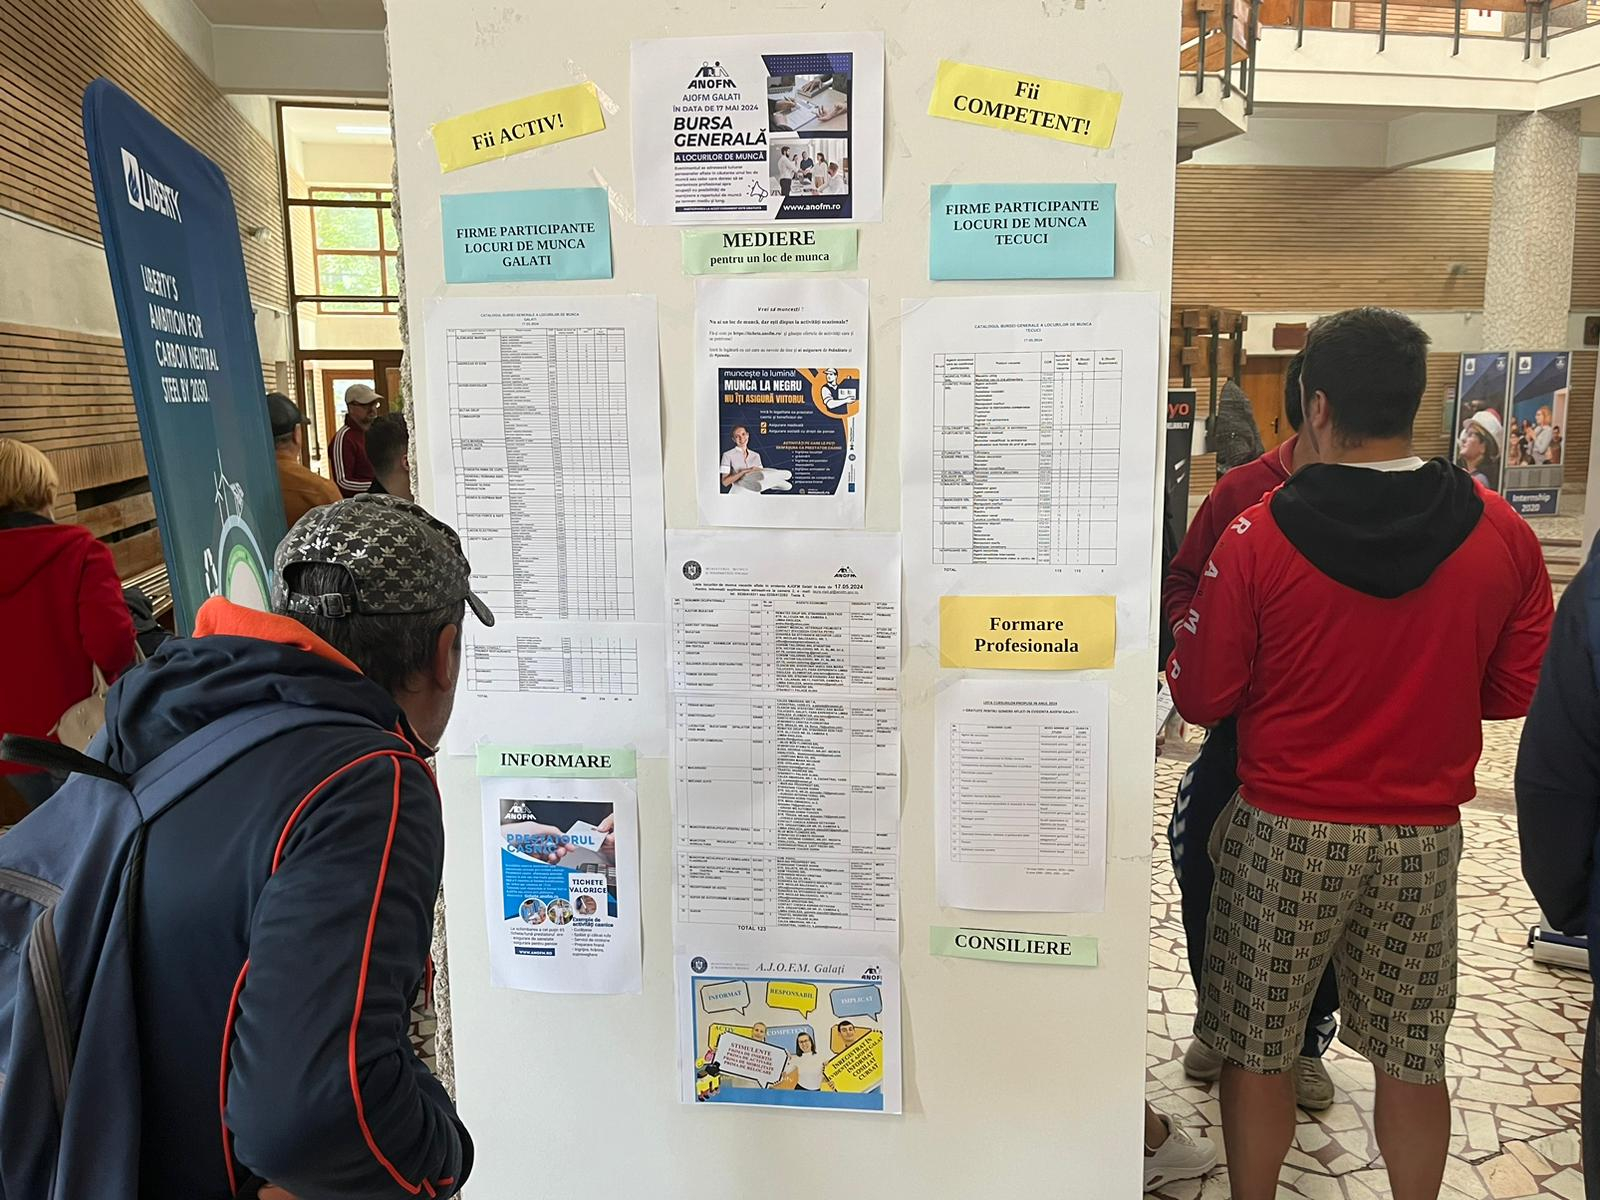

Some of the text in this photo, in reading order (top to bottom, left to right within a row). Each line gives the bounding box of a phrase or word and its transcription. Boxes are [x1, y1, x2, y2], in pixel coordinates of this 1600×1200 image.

[687, 79, 737, 89] ANOFM
[1015, 81, 1040, 100] Fii
[712, 93, 741, 101] GALATI
[741, 104, 759, 112] 2024
[953, 95, 1091, 136] COMPETENT!
[674, 116, 733, 130] BURSA
[472, 113, 564, 150] Fii ACTIV!
[674, 129, 767, 147] GENERALĂ
[682, 153, 723, 161] LOCURILOR
[735, 151, 764, 160] MUNCĂ
[141, 168, 183, 223] LIBERTY
[783, 203, 841, 212] www.anofm.ro
[946, 200, 1099, 215] FIRME PARTICIPANTE
[456, 223, 595, 238] FIRME PARTICIPANTE
[954, 217, 1087, 231] LOCURI DE MUNCA
[465, 239, 585, 254] LOCURI DE MUNCA
[723, 231, 816, 248] MEDIERE
[995, 234, 1048, 245] TECUCI
[502, 255, 551, 267] GALATI
[710, 255, 744, 267] pentru
[763, 253, 778, 264] loc
[780, 253, 793, 262] de
[795, 254, 830, 262] munca
[141, 264, 179, 302] LIBERTY'S
[149, 303, 204, 339] AMBITION FOR
[155, 340, 220, 371] CARBON NEUTRAL
[161, 376, 182, 404] STEEL
[180, 378, 191, 403] BY
[724, 379, 802, 391] MUNCA LA NEGRU
[724, 394, 734, 403] NU
[745, 393, 775, 403] ASIGURĂ
[775, 394, 806, 404] VIITORUL
[1512, 493, 1551, 503] Internship
[990, 617, 1064, 631] Formare
[975, 638, 1079, 653] Profesionala
[501, 753, 612, 768] INFORMARE
[506, 833, 596, 846] PRESTATORUL
[570, 886, 607, 894] VALORICE
[955, 934, 1072, 956] CONSILIERE
[755, 963, 810, 974] A.J.O.F.M.
[814, 964, 845, 975] Galați
[708, 990, 742, 1001] INFORMAT
[730, 1042, 772, 1056] STIMULENTE
